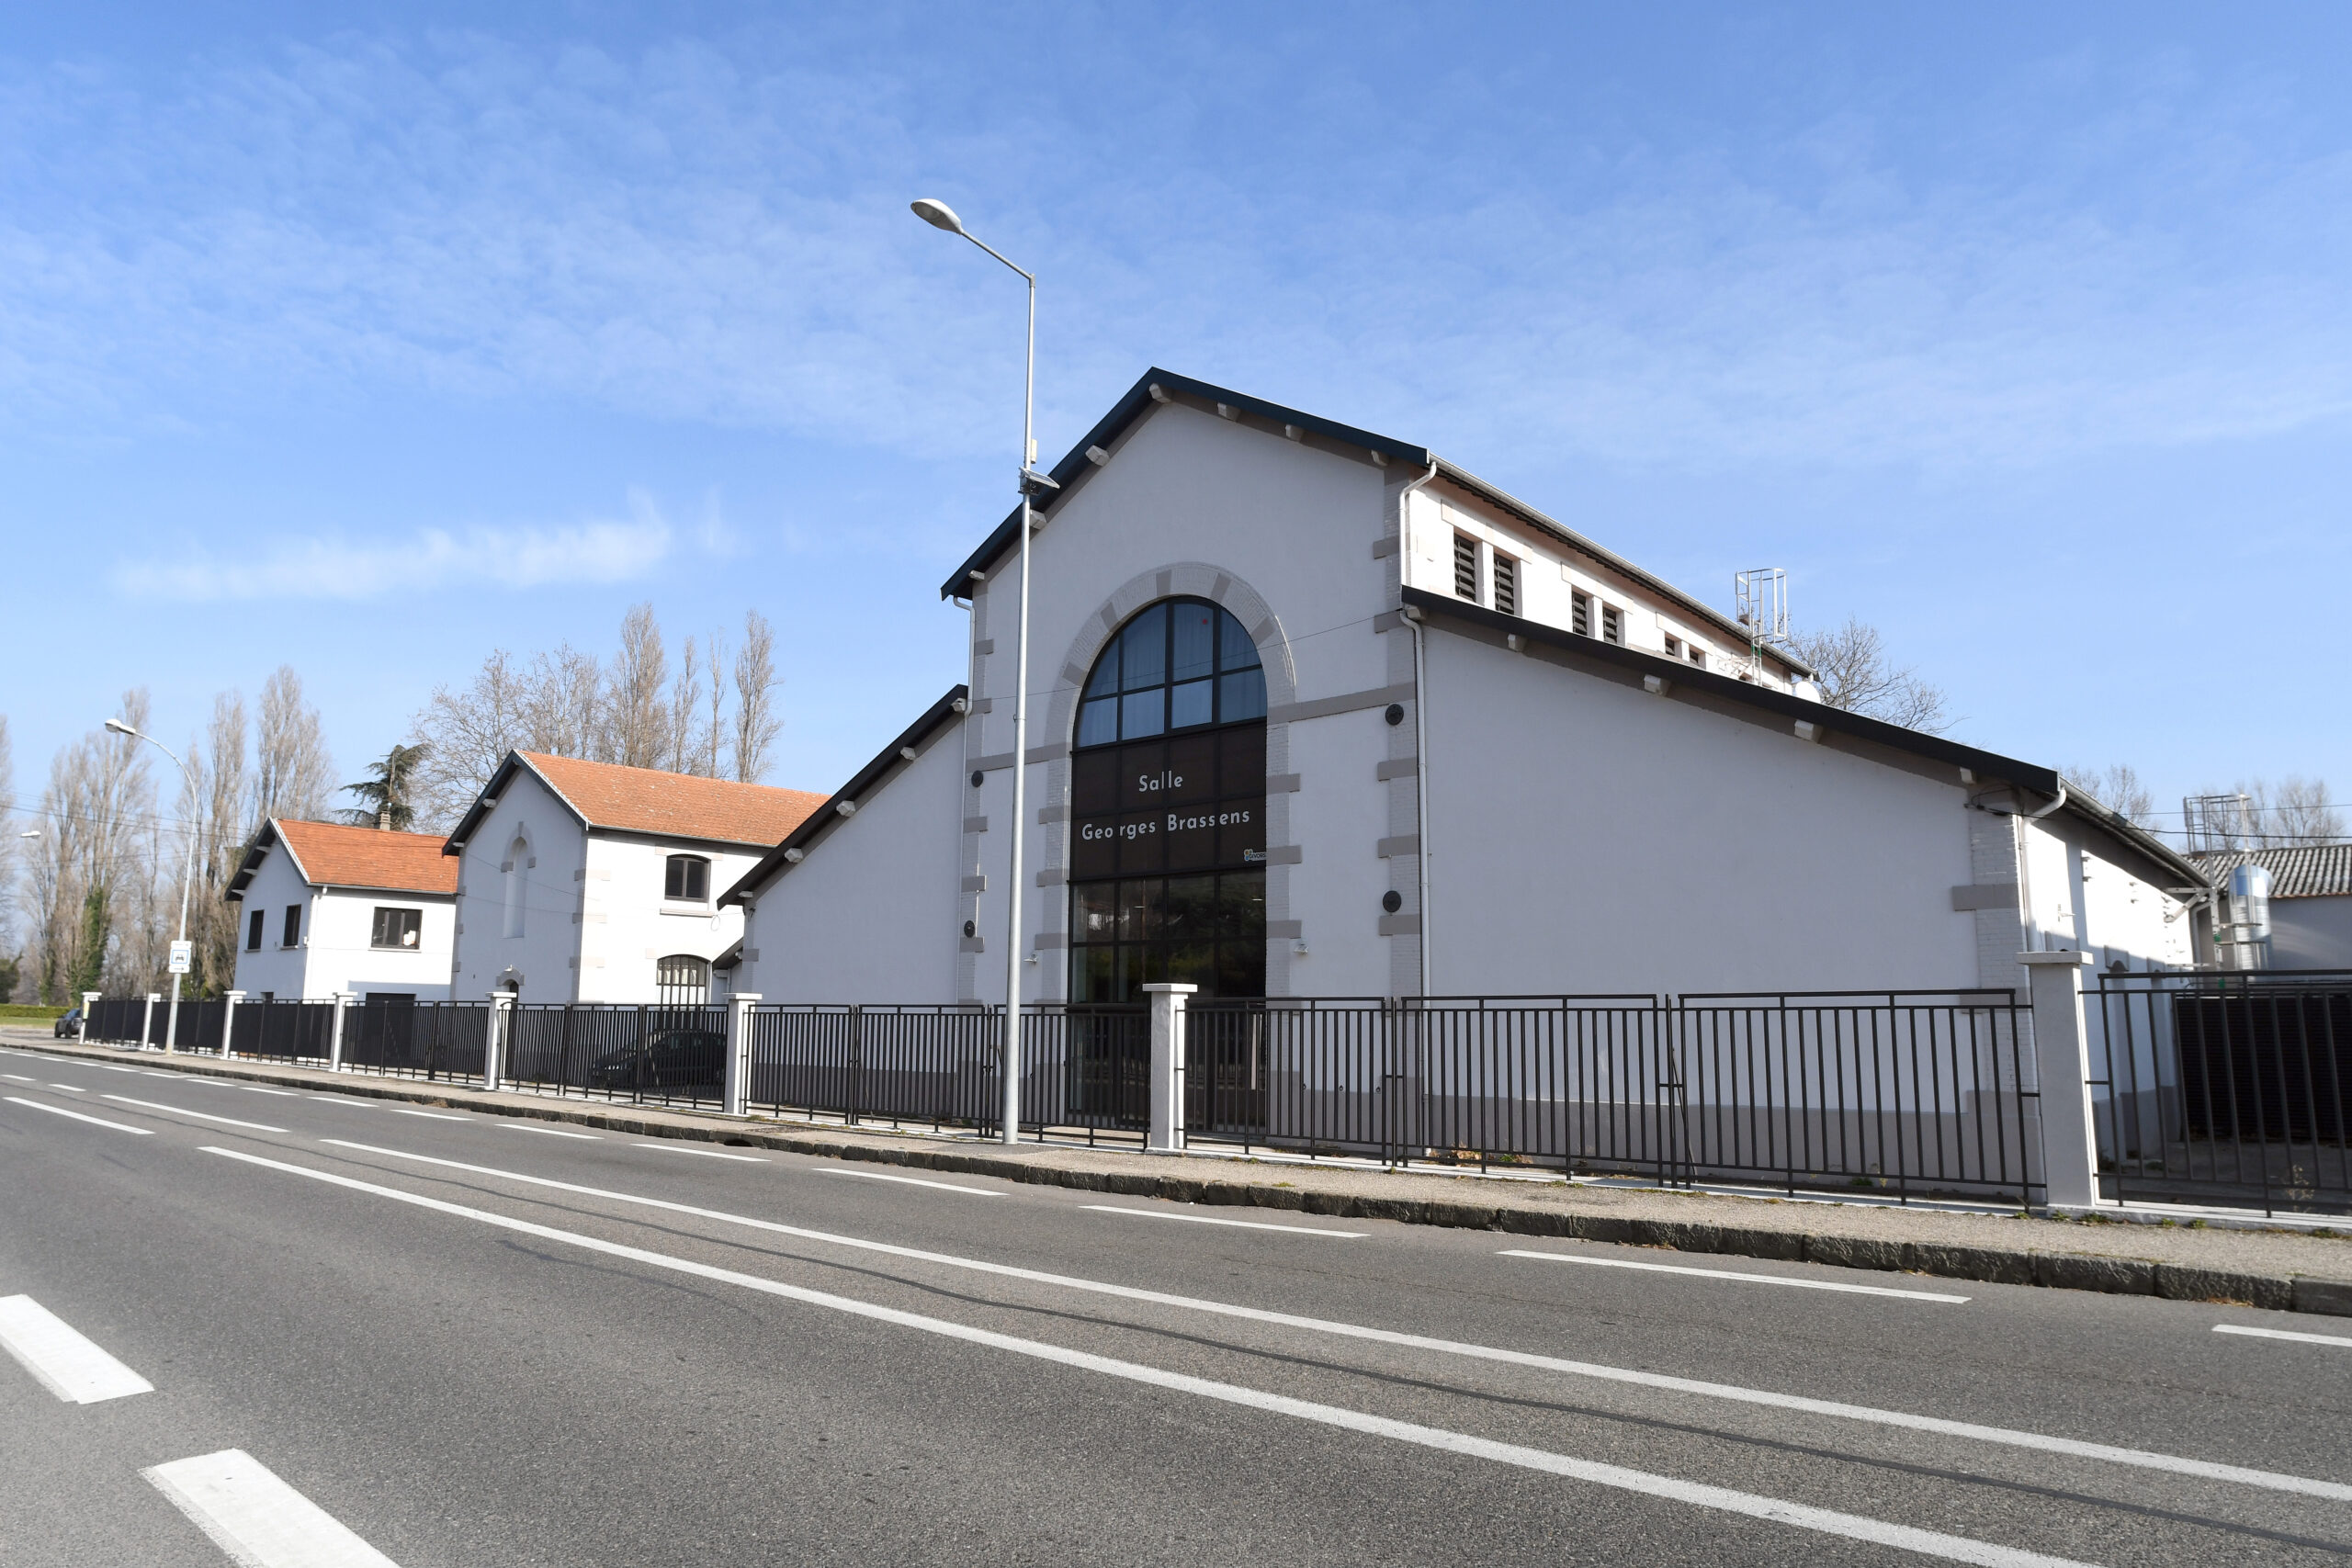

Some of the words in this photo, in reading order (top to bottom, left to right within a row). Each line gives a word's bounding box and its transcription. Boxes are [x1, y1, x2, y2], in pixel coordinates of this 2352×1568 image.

[1138, 770, 1183, 792] Salle
[1081, 820, 1156, 840] Georges
[1168, 810, 1250, 831] Brassens
